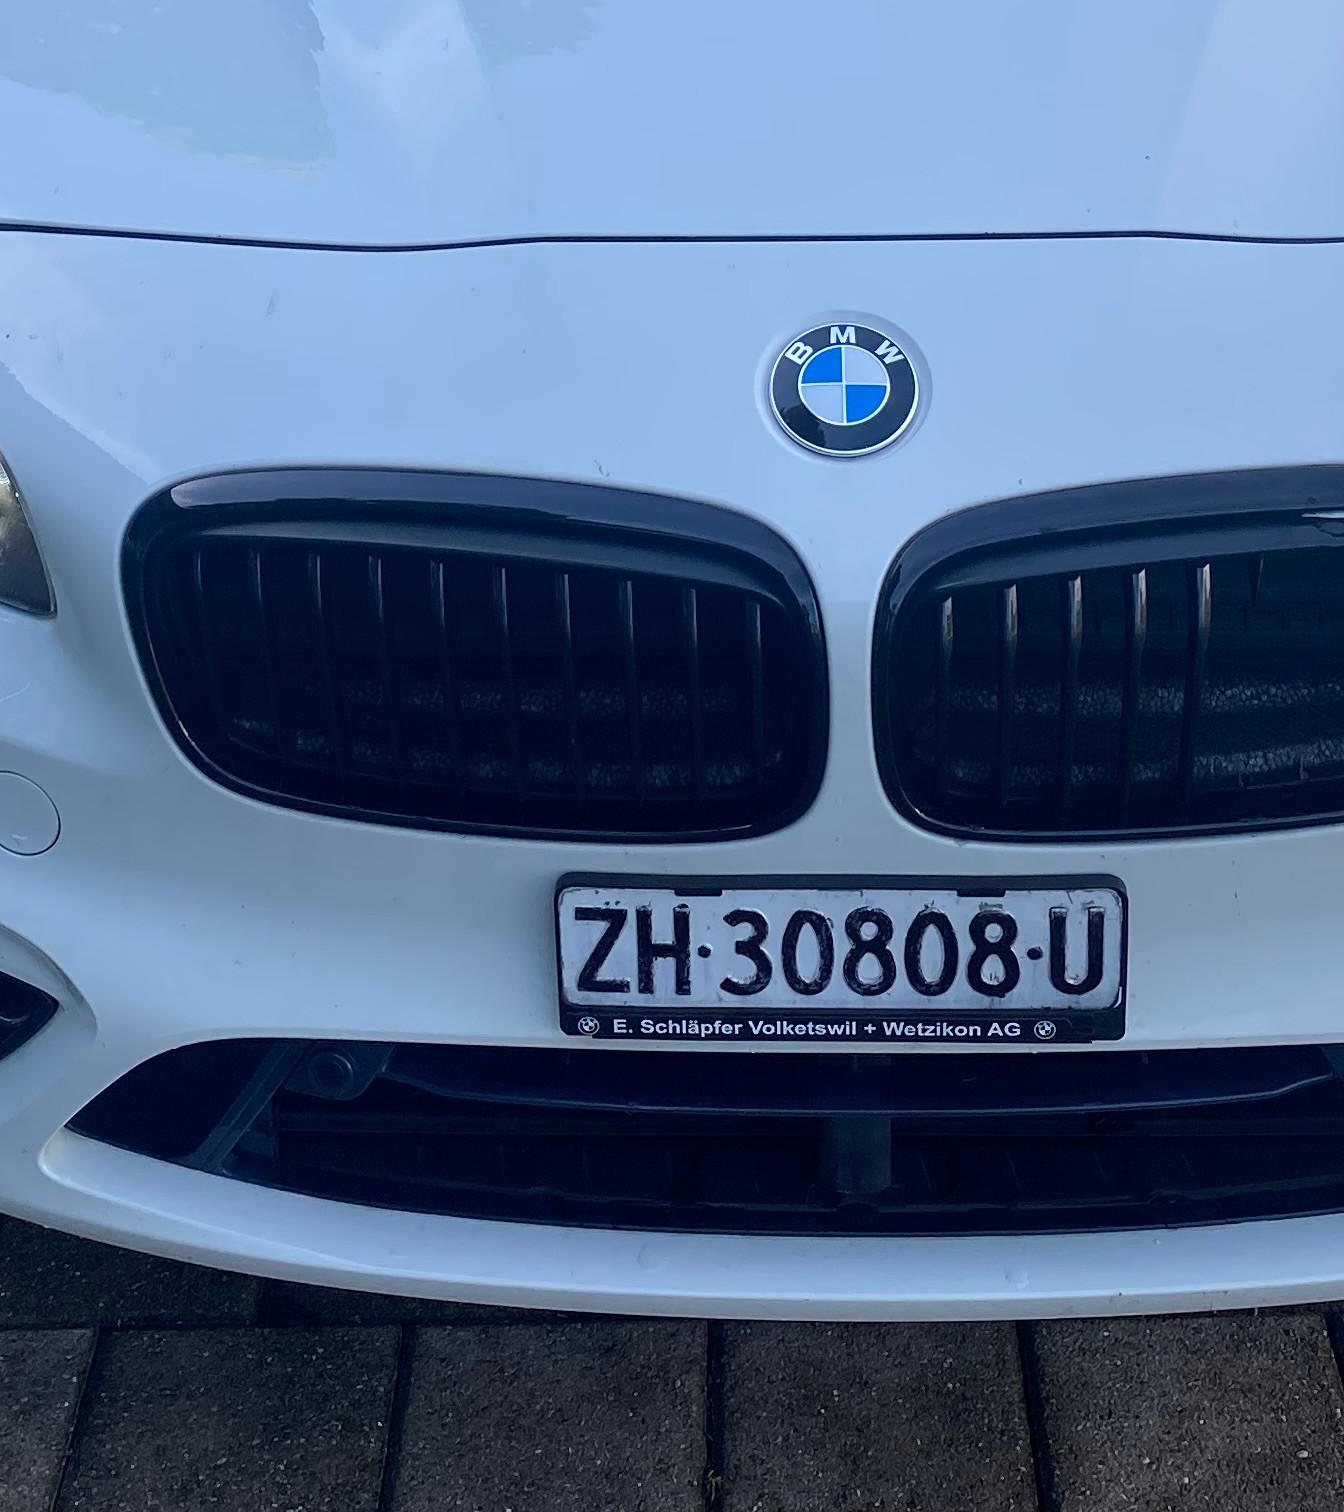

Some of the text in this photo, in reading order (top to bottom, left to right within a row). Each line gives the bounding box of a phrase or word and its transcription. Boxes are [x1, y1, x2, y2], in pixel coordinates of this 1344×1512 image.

[784, 326, 905, 365] BMW
[612, 1018, 1022, 1038] E. Schläpfer Volketswil + Wetzikon AG
